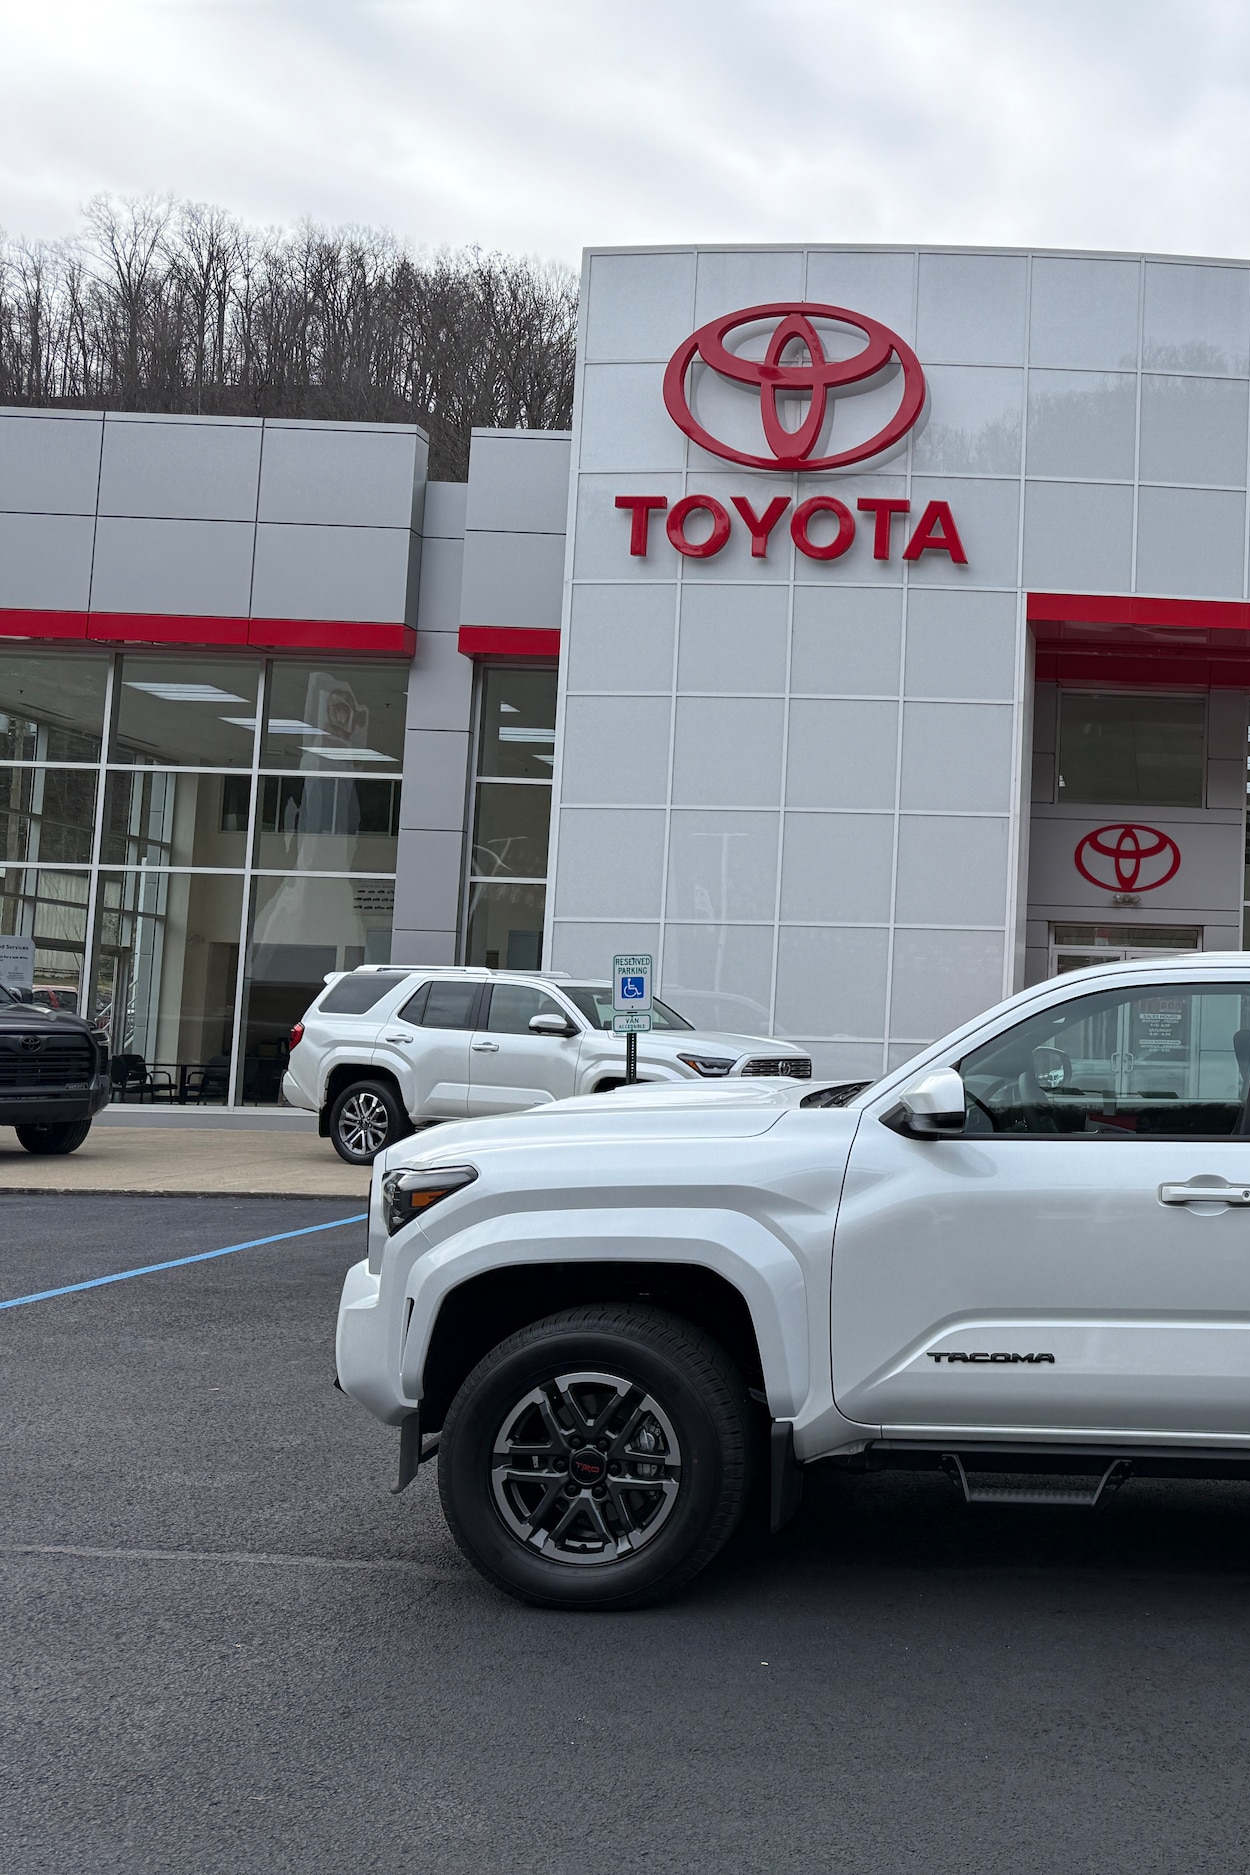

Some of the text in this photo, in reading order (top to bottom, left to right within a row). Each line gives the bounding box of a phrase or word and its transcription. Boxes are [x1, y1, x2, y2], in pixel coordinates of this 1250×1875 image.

[615, 494, 969, 565] TOYOTA
[615, 957, 651, 966] RESERVED
[618, 967, 648, 975] PARKING
[927, 1352, 1056, 1364] TACOMA
[575, 1461, 600, 1473] TRD
